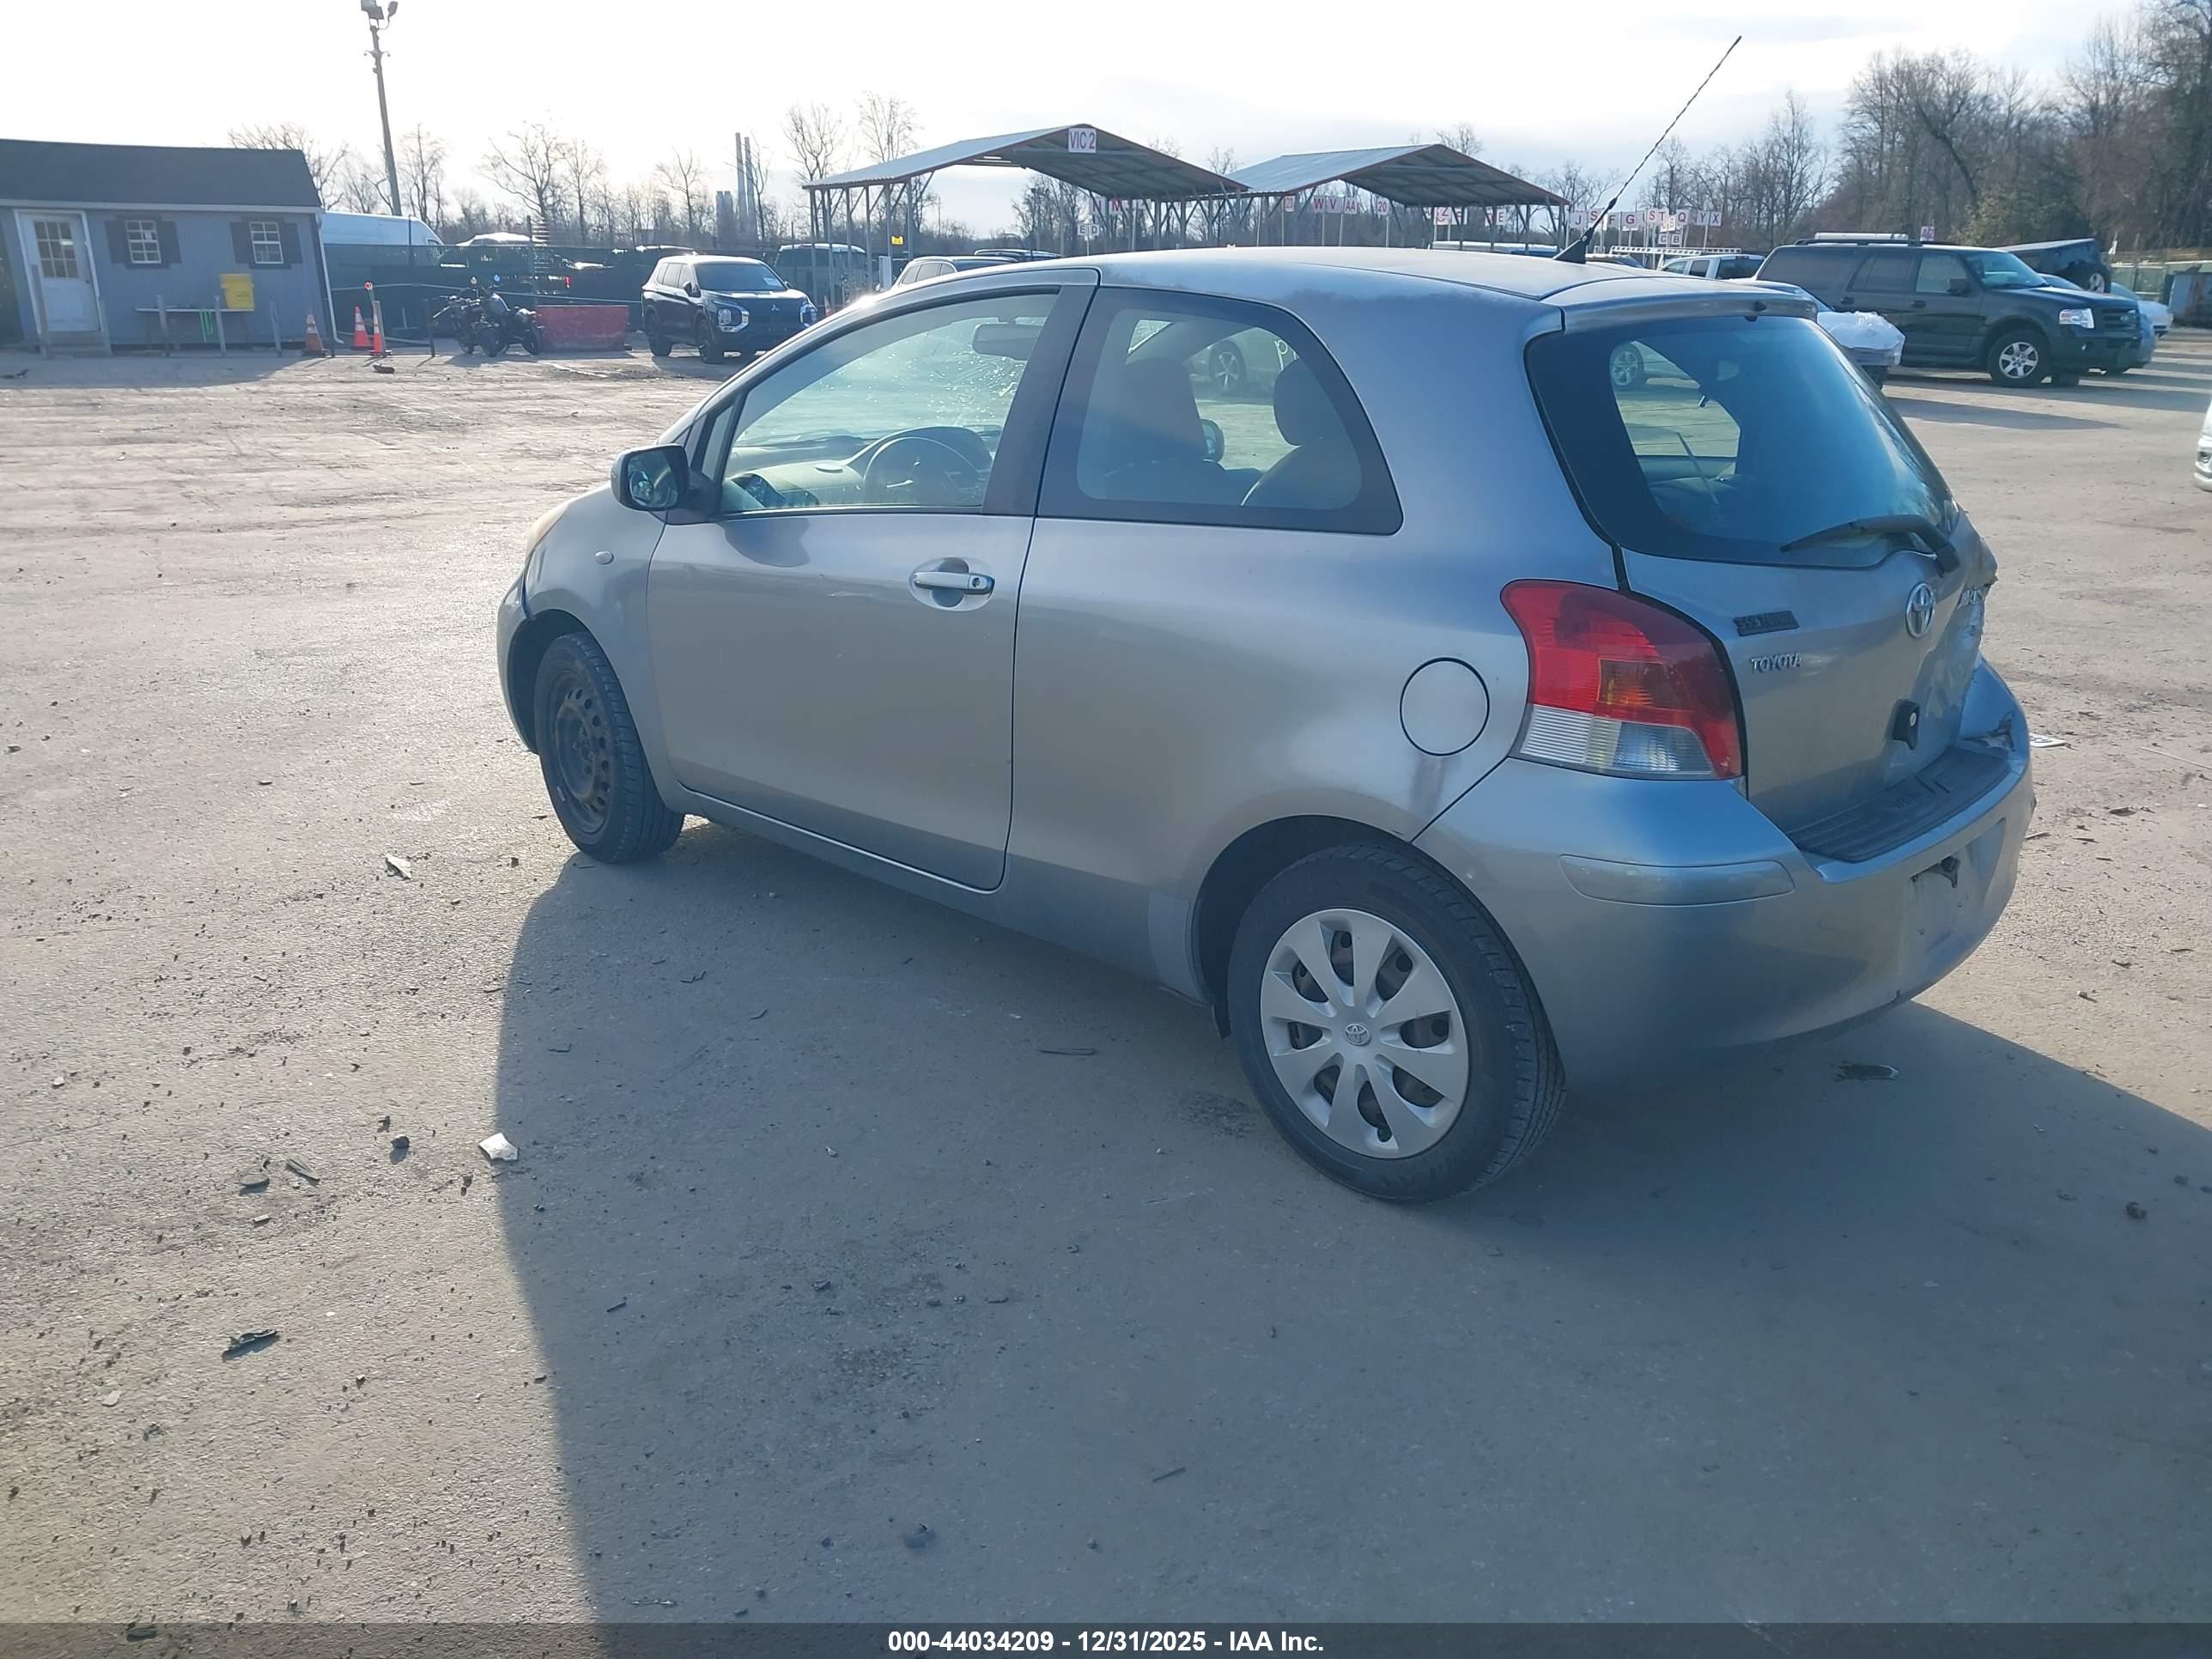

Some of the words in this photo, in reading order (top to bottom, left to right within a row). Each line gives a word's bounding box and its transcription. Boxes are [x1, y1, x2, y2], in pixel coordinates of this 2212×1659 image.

[1069, 131, 1086, 149] VIC
[1089, 131, 1096, 149] 2
[1314, 198, 1324, 210] W
[1329, 199, 1338, 210] V
[1377, 202, 1387, 212] 20
[1575, 216, 1583, 225] J
[1609, 215, 1616, 224] F
[1626, 214, 1635, 224] G
[1649, 210, 1656, 221] S
[1659, 211, 1666, 222] T
[1677, 212, 1686, 222] Q
[1700, 213, 1707, 223] Y
[1712, 214, 1720, 223] X
[1079, 225, 1086, 234] E
[1091, 225, 1098, 234] D
[1750, 653, 1802, 673] TOYOTA
